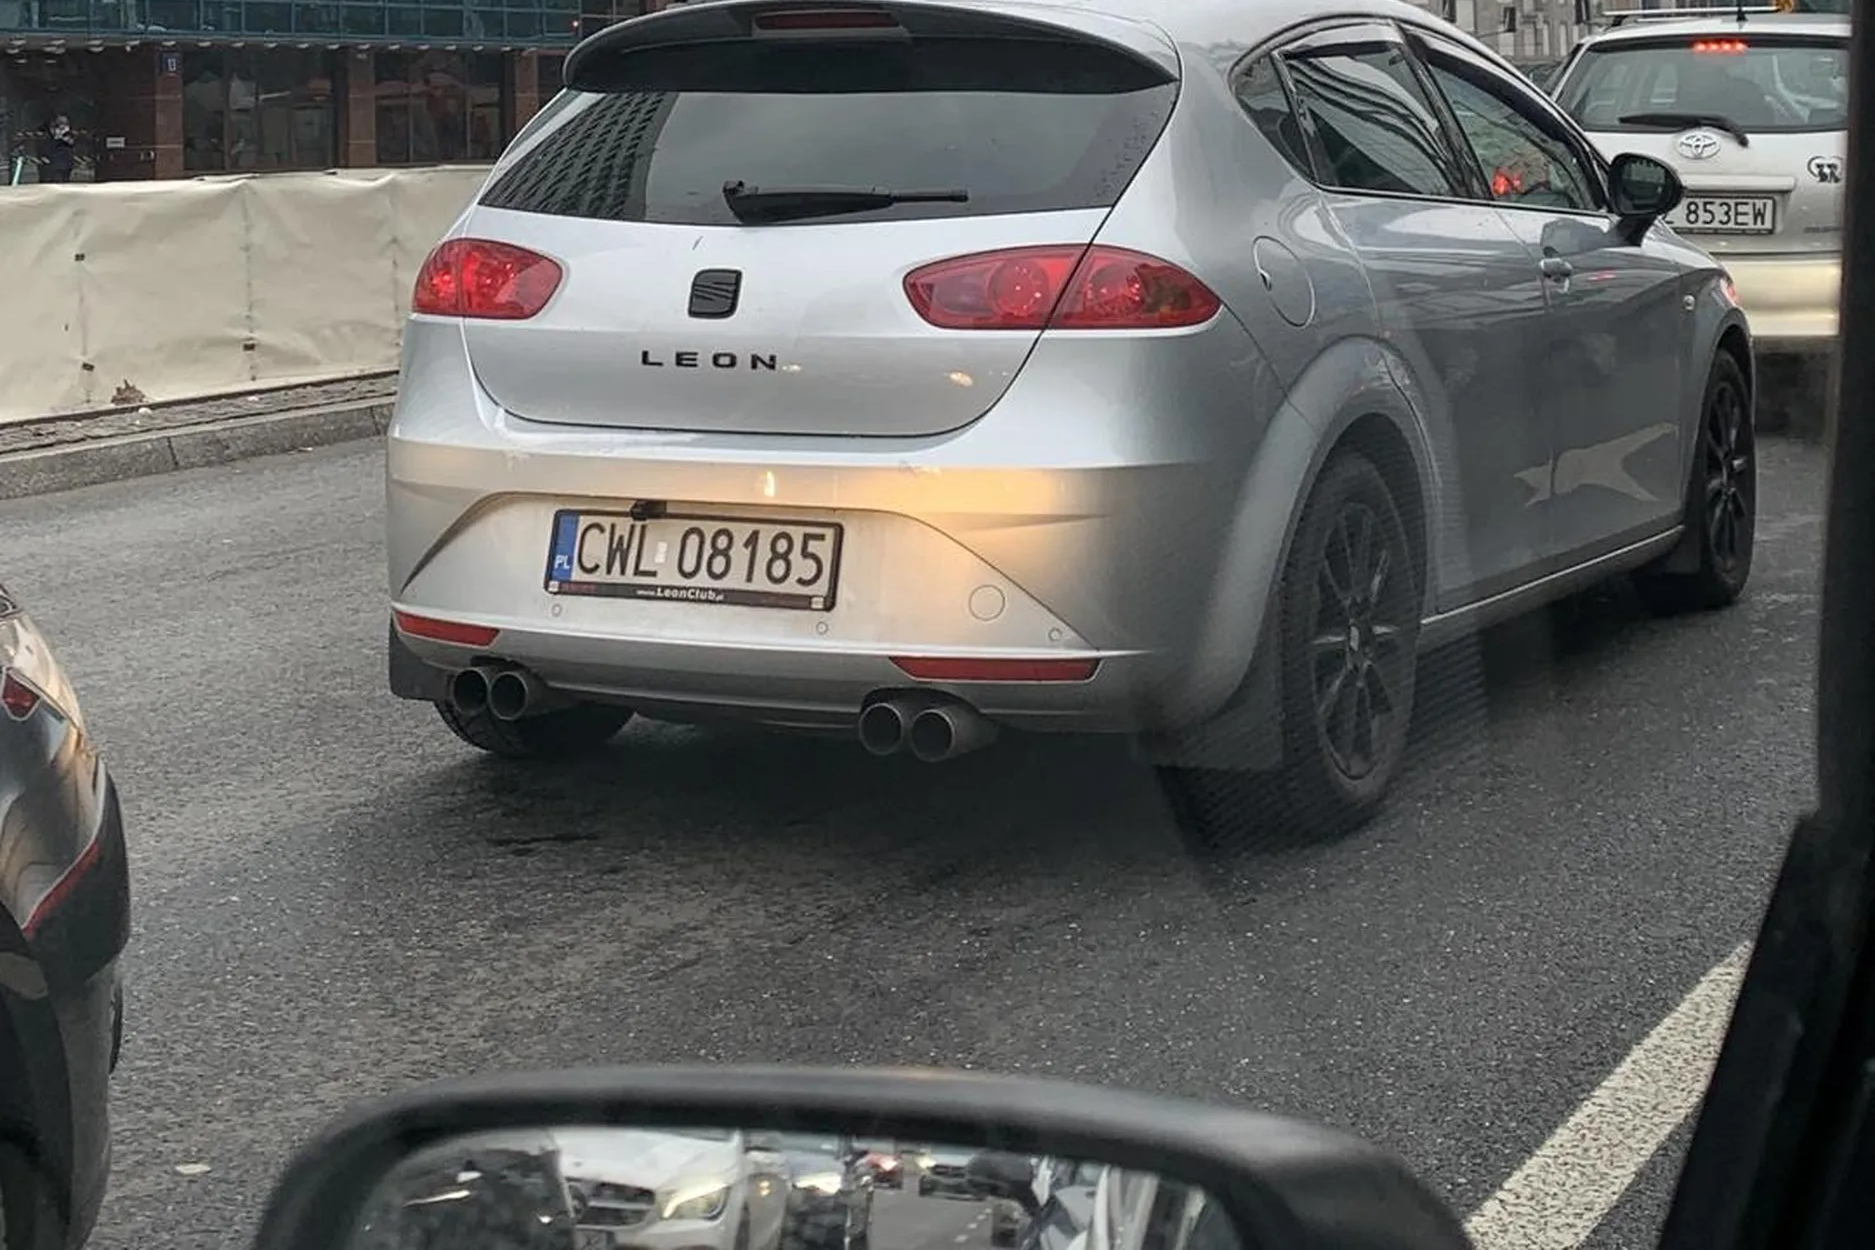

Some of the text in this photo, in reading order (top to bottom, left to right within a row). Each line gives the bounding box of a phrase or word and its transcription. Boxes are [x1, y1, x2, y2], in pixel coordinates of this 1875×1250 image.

[1685, 201, 1767, 226] 853EW
[641, 350, 777, 371] LEON
[554, 554, 571, 570] PL
[578, 522, 826, 587] CWL 08185
